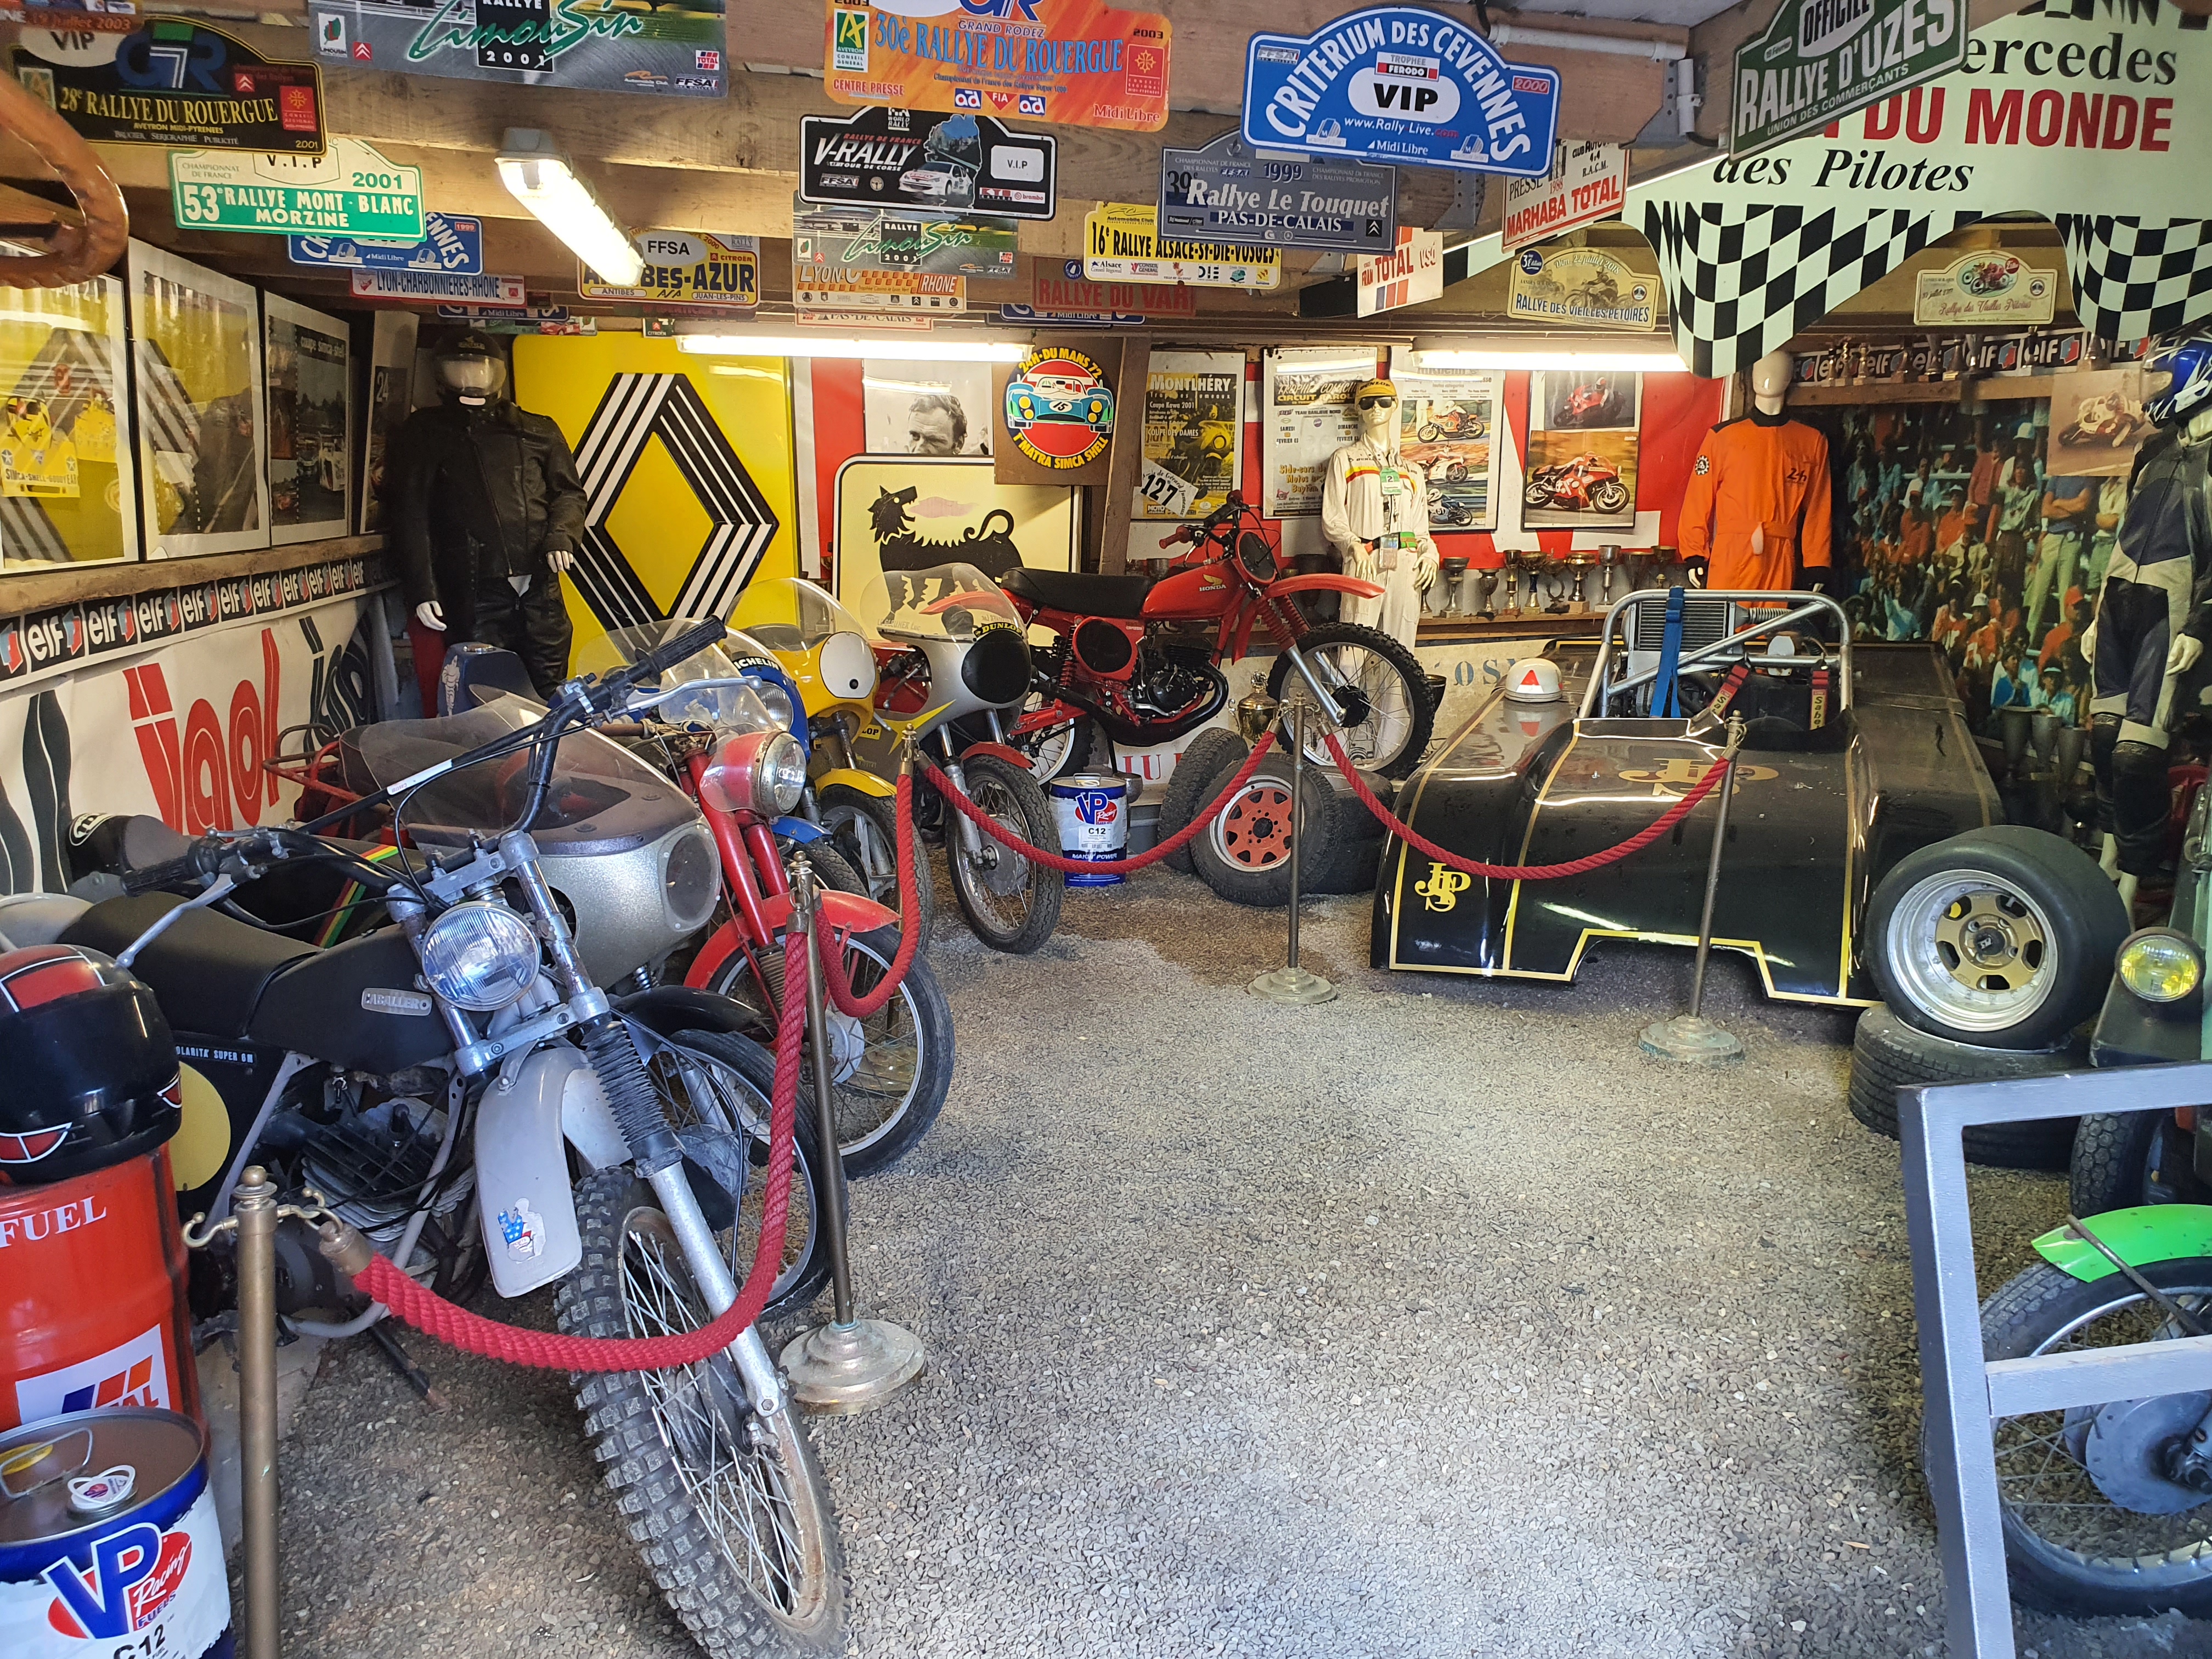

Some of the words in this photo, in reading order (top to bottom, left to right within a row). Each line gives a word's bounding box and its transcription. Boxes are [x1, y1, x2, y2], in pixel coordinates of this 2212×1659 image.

[959, 20, 1001, 33] GRAND
[1006, 25, 1046, 38] RODEZ
[1133, 29, 1164, 39] 2003
[50, 31, 95, 50] VIP
[916, 22, 988, 68] RALLYE
[995, 36, 1020, 71] DU
[1025, 39, 1124, 74] ROUERGUE
[1391, 54, 1426, 66] TROPHEE
[1389, 65, 1425, 77] FERODO
[675, 78, 713, 87] FFSA
[833, 79, 867, 93] CENTRE
[871, 81, 905, 96] PRESSE
[1266, 18, 1386, 138] CRITERIUM
[1391, 21, 1429, 47] DES
[1433, 26, 1531, 162] CEVENNES
[1515, 77, 1549, 93] 2000
[992, 92, 1009, 103] FIA
[1374, 83, 1438, 112] VIP
[1738, 58, 1829, 138] RALLYE
[1767, 114, 1798, 137] UNION
[1800, 105, 1819, 122] DES
[1821, 63, 1910, 112] COMMERÇANTS
[86, 91, 154, 122] RALLYE
[156, 99, 179, 124] DU
[186, 99, 278, 125] ROUERGUE
[1093, 103, 1124, 119] Midi
[1126, 106, 1161, 123] Libre
[134, 123, 168, 131] AVEYRON
[170, 125, 224, 134] MIDI-PYRENEES
[1864, 87, 1946, 144] DU
[1965, 87, 2175, 153] MONDE
[296, 140, 318, 149] 2001
[843, 133, 874, 141] RALLYE
[890, 137, 922, 145] FRANCE
[1376, 140, 1401, 154] Midi
[1402, 142, 1429, 156] Libre
[814, 133, 919, 166] V-RALLY
[182, 162, 240, 172] CHAMPIONNAT
[1007, 160, 1028, 170] V.I.P
[1175, 157, 1220, 165] CHAMPIONNAT
[1811, 148, 1975, 193] Pilotes
[352, 172, 403, 189] 2001
[823, 177, 854, 185] FFSA
[1263, 163, 1303, 183] 1999
[1312, 167, 1354, 176] CHAMPIONNAT
[1510, 177, 1543, 201] PRESSE
[1549, 177, 1564, 194] 1988
[1186, 179, 1260, 208] Rallye
[1268, 189, 1292, 211] Le
[1300, 191, 1389, 218] Touquet
[1507, 194, 1567, 239] MARHABA
[1571, 174, 1621, 214] TOTAL
[256, 208, 349, 228] MORZINE
[455, 222, 476, 231] 1999
[884, 223, 918, 232] RALLYE
[1218, 210, 1342, 233] PAS-DE-CALAIS
[371, 253, 386, 262] Midi
[647, 240, 690, 256] FFSA
[1375, 246, 1414, 284] TOTAL
[695, 293, 746, 301] JUAN-LES-PINS
[1039, 278, 1103, 307] RALLYE
[1109, 285, 1134, 308] DU
[1141, 284, 1189, 309] VAR
[1516, 293, 1548, 313] RALLYE
[1550, 300, 1567, 314] DES
[1569, 305, 1606, 319] VIEILLES
[1608, 306, 1650, 323] PETOIRES
[1042, 347, 1058, 359] DU
[1059, 347, 1091, 368] MANS
[1088, 362, 1103, 379] 72
[376, 371, 390, 403] 24
[1149, 374, 1232, 392] MONTLHÉRY
[1052, 402, 1069, 411] 15
[1149, 401, 1165, 410] Coupe
[1148, 428, 1166, 437] COUPE
[1167, 428, 1178, 437] DES
[1179, 428, 1199, 437] DAMES
[1140, 474, 1179, 507] 127
[309, 568, 323, 595] elf
[331, 565, 345, 590] elf
[353, 560, 365, 585] elf
[253, 578, 271, 608] elf
[283, 573, 298, 602] elf
[1199, 584, 1227, 592] HONDA
[182, 589, 205, 623] elf
[220, 583, 240, 614] elf
[88, 604, 117, 645] elf
[138, 596, 165, 634] elf
[28, 616, 64, 661] elf
[982, 622, 1023, 635] DUNLOP
[1075, 792, 1109, 825] VP
[1097, 809, 1117, 821] Racing
[366, 992, 431, 1011] CABALLERO
[0, 1195, 108, 1249] FUEL
[40, 1522, 162, 1639] VP
[133, 1539, 191, 1618] Racing
[136, 1592, 177, 1630] FUELS
[114, 1623, 166, 1659] C12
